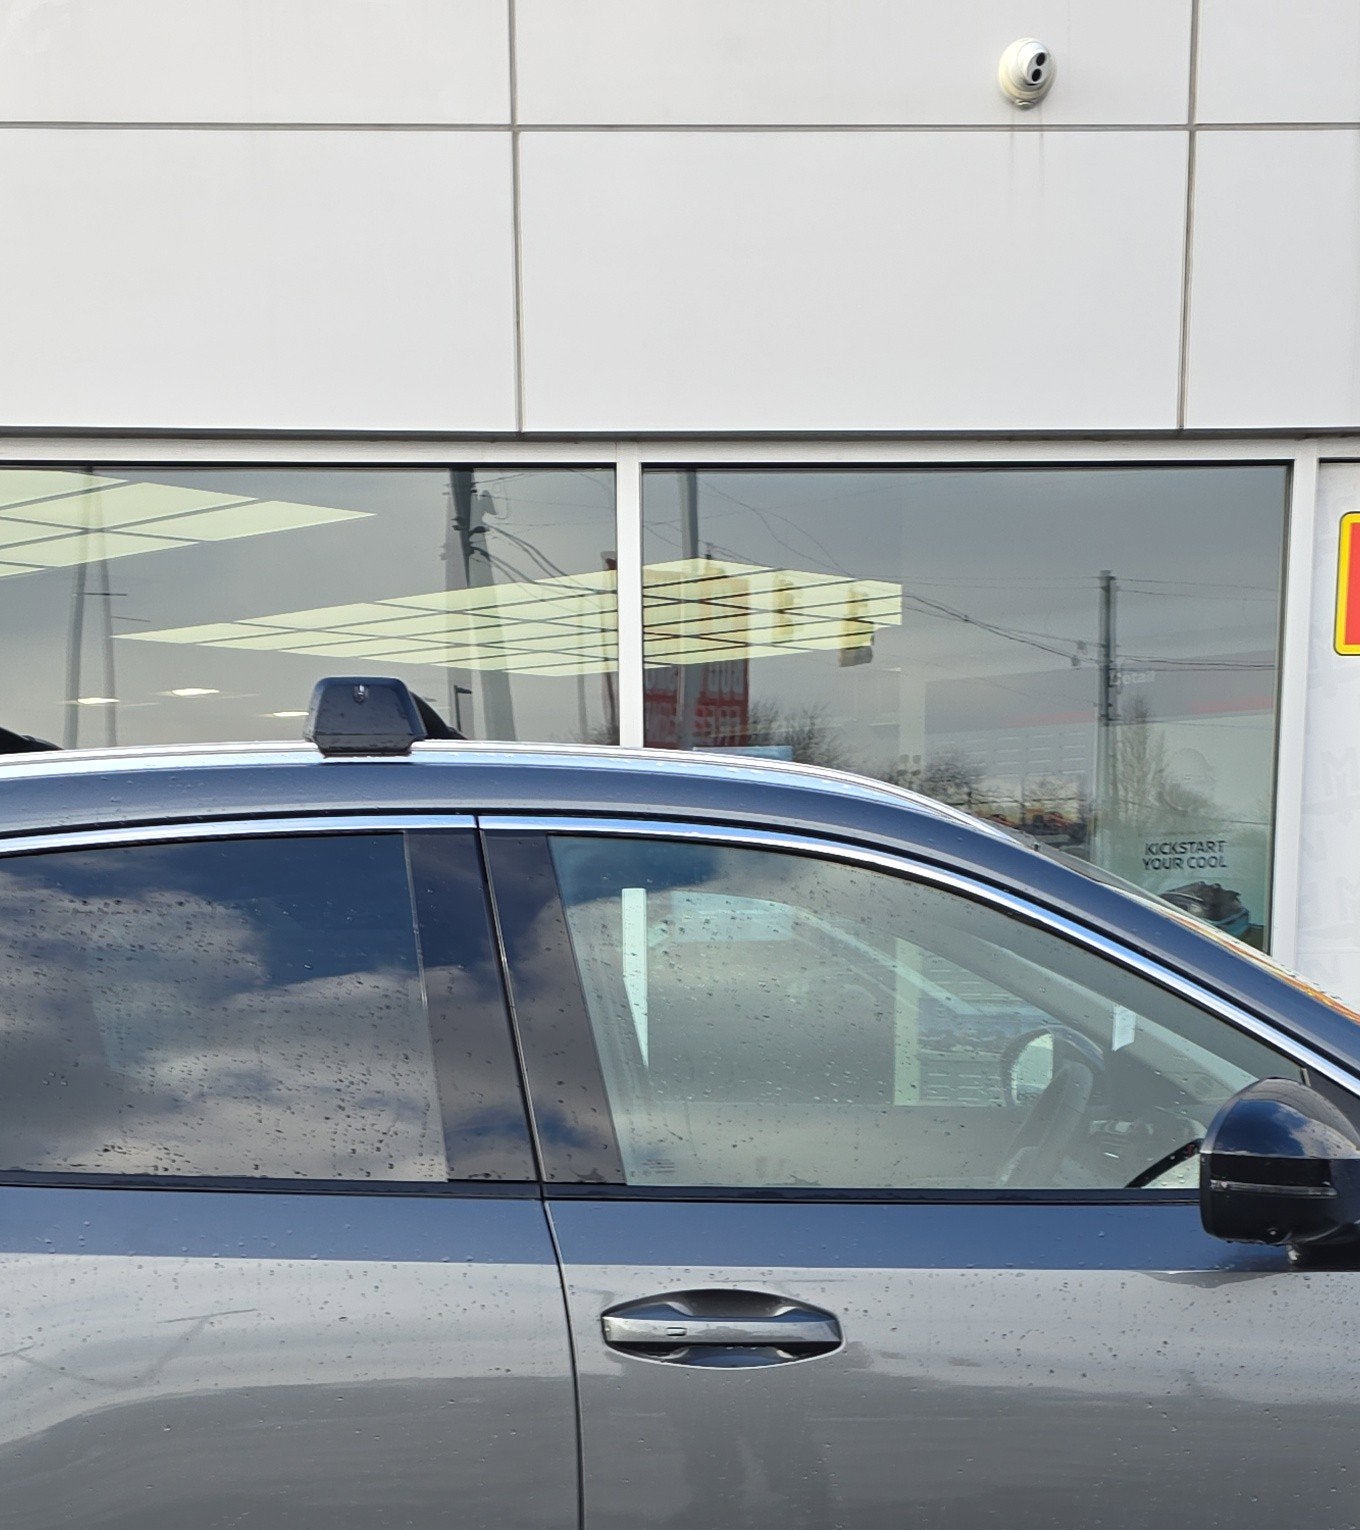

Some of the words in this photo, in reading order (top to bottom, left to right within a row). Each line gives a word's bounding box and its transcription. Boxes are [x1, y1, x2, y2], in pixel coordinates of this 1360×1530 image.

[1144, 840, 1228, 856] KICKSTART
[1142, 856, 1183, 870] YOUR
[1186, 855, 1228, 869] COOL
